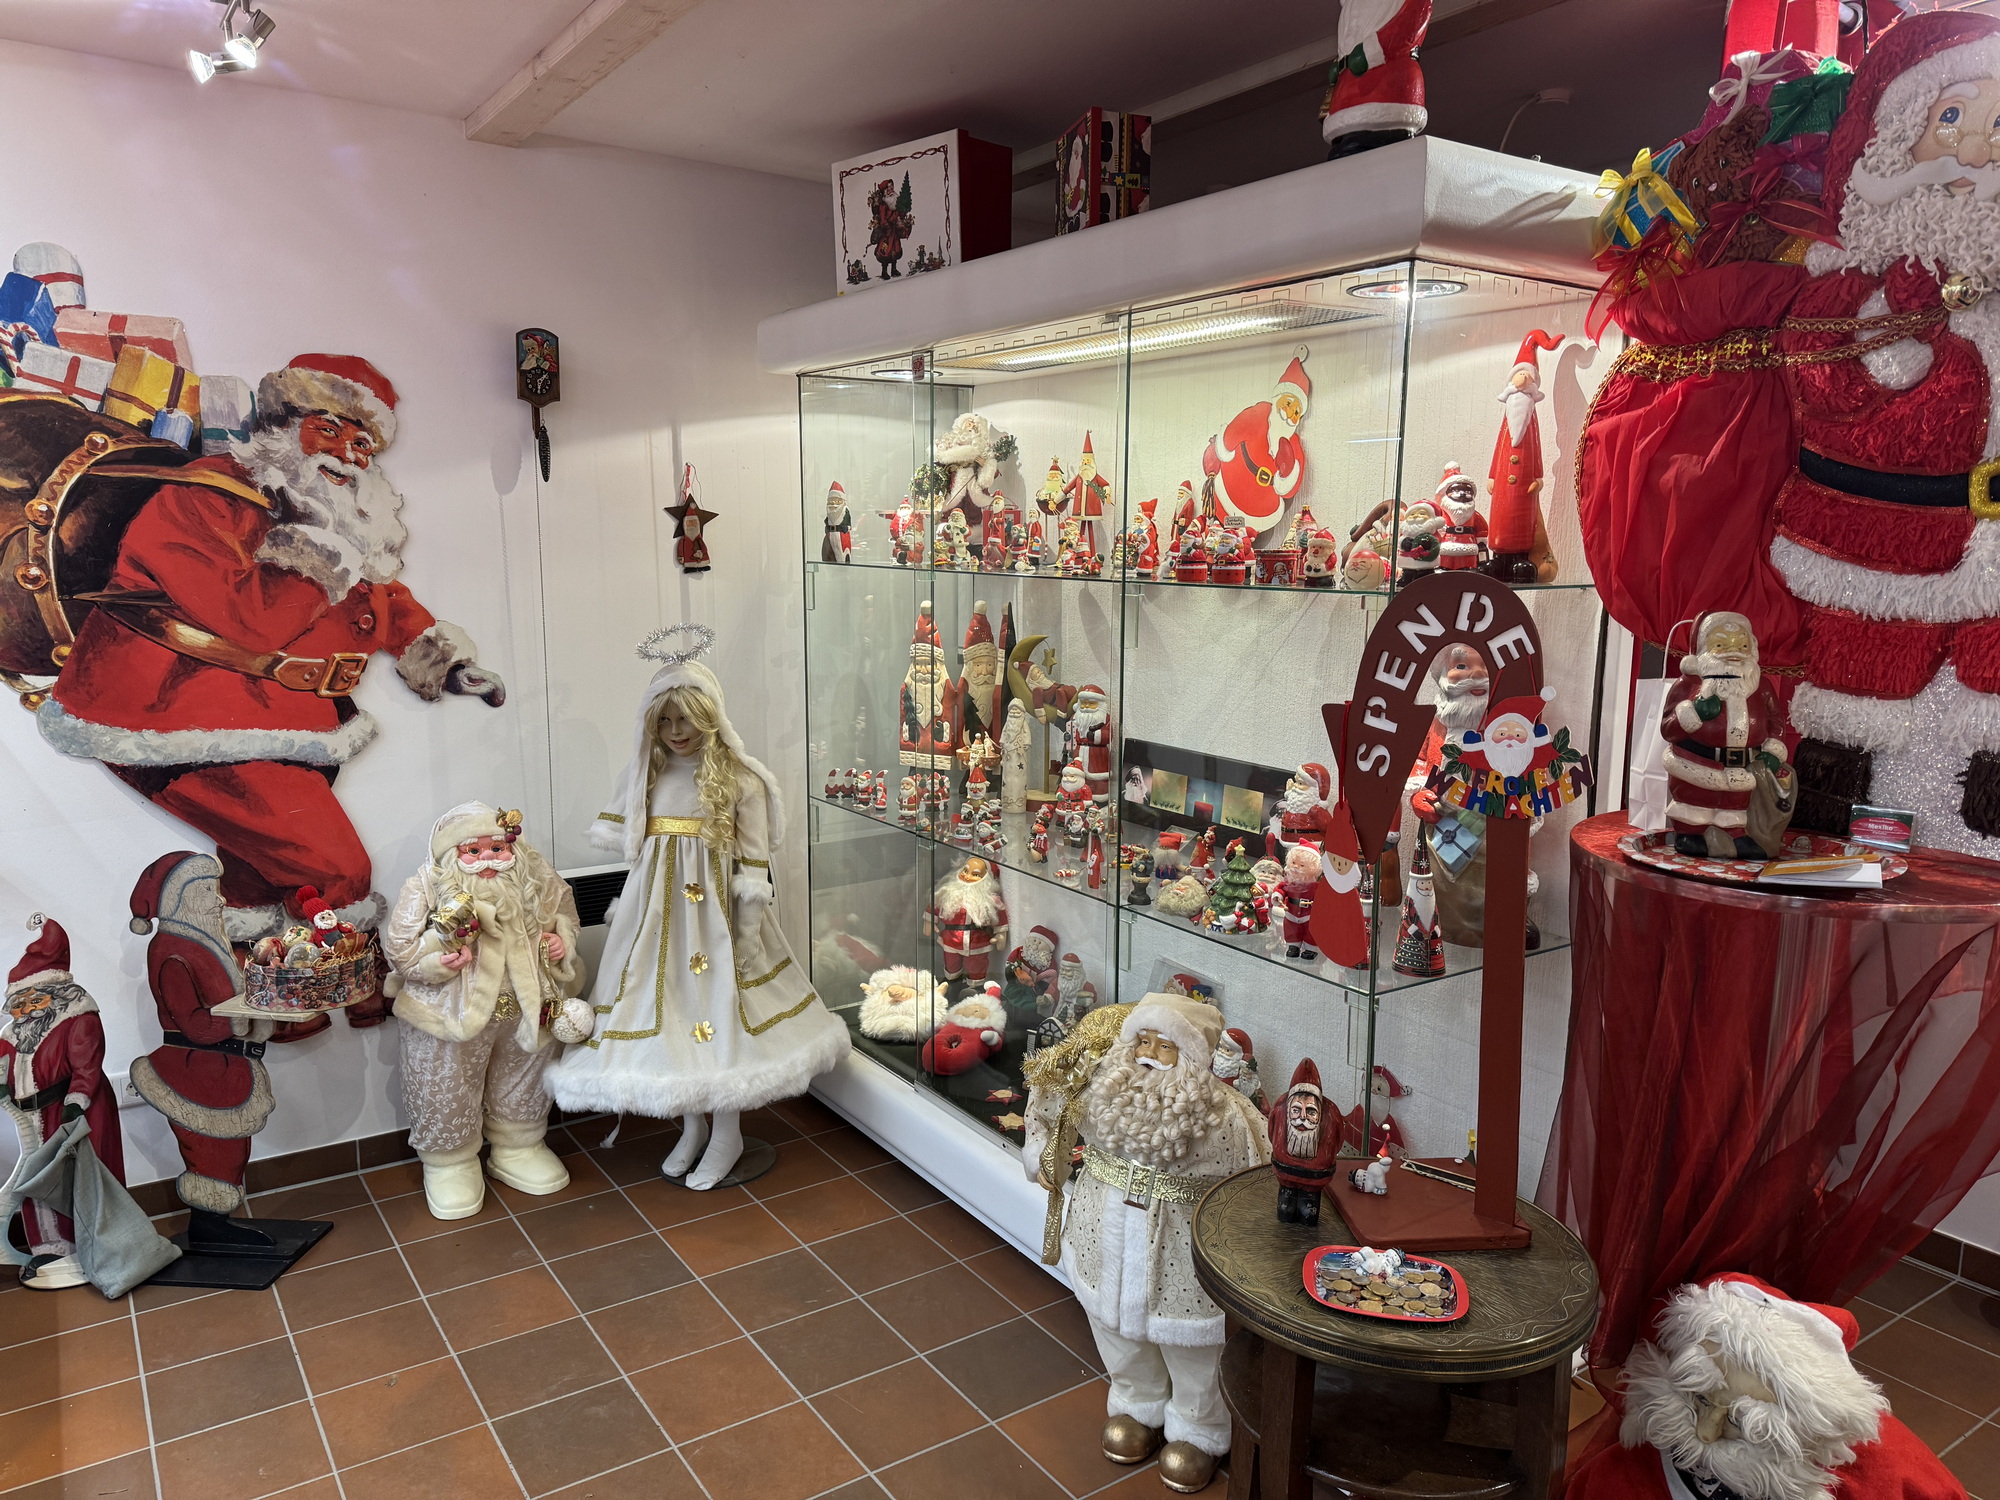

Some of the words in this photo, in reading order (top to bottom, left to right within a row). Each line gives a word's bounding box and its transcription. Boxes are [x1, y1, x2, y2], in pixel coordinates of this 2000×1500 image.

[1356, 591, 1536, 778] SPENDE
[1425, 754, 1594, 819] WEIHNACHTEN
[1472, 767, 1550, 796] FROHE
